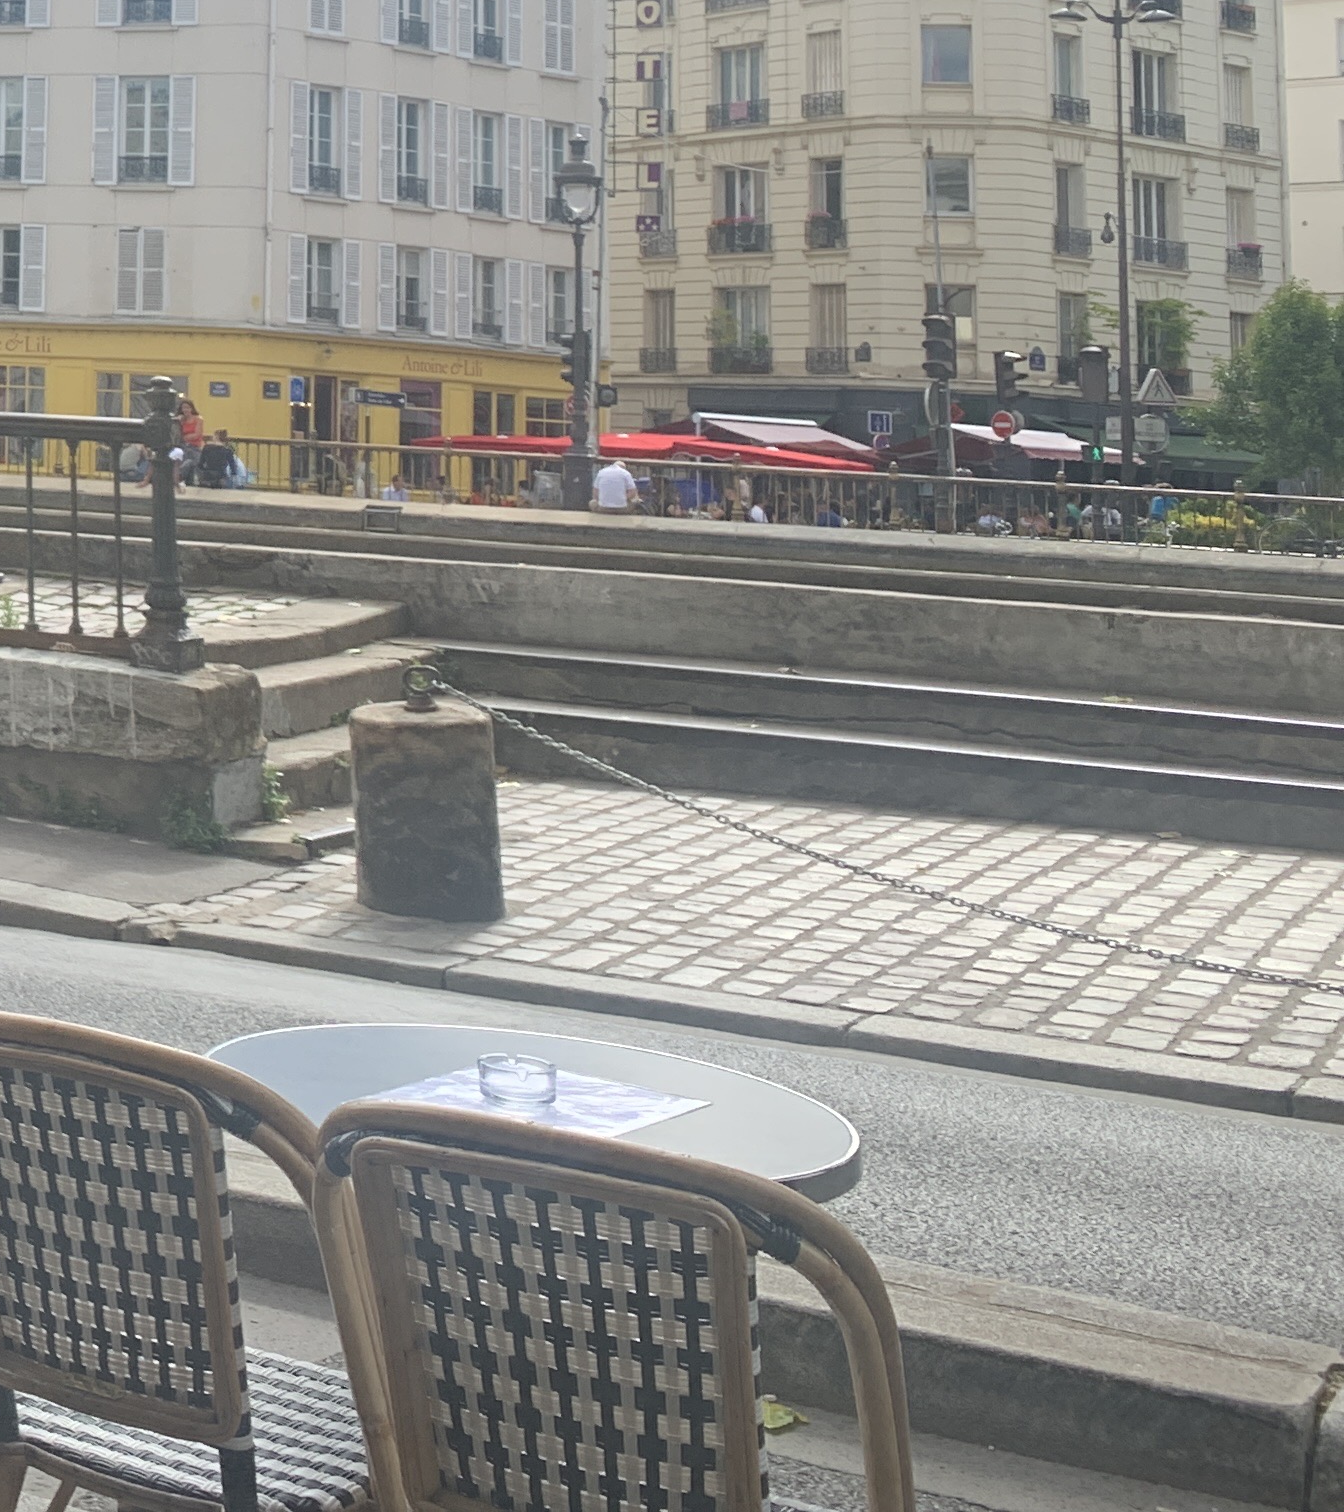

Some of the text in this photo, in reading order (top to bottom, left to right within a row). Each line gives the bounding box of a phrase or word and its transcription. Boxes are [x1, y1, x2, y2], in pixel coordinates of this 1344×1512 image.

[5, 333, 23, 351] &
[25, 335, 51, 353] Lili
[402, 355, 448, 374] Antoine
[464, 359, 483, 377] Lili
